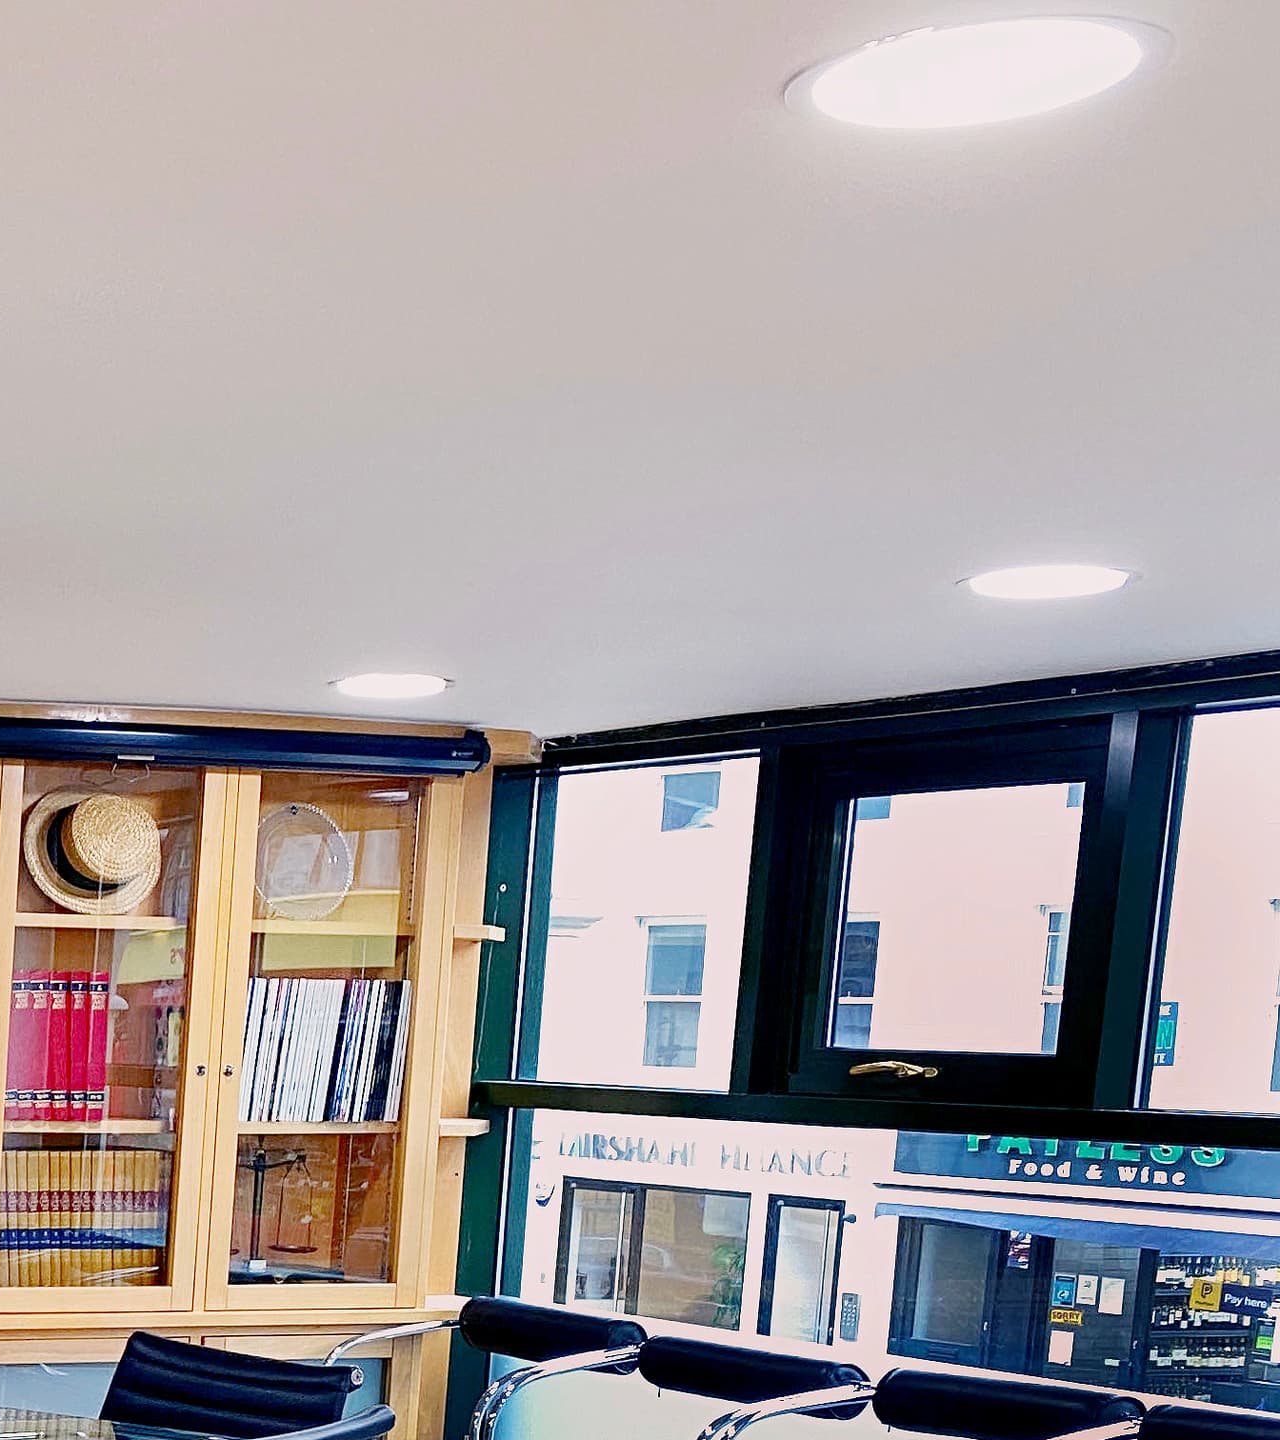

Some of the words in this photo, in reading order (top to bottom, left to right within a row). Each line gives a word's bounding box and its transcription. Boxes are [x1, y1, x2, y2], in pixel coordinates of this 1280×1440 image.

[1008, 1159, 1072, 1178] Food
[1085, 1165, 1103, 1181] &
[1117, 1166, 1187, 1186] Wine
[1224, 1293, 1244, 1307] Pay
[1244, 1297, 1267, 1308] here
[1052, 1310, 1081, 1321] SORRY
